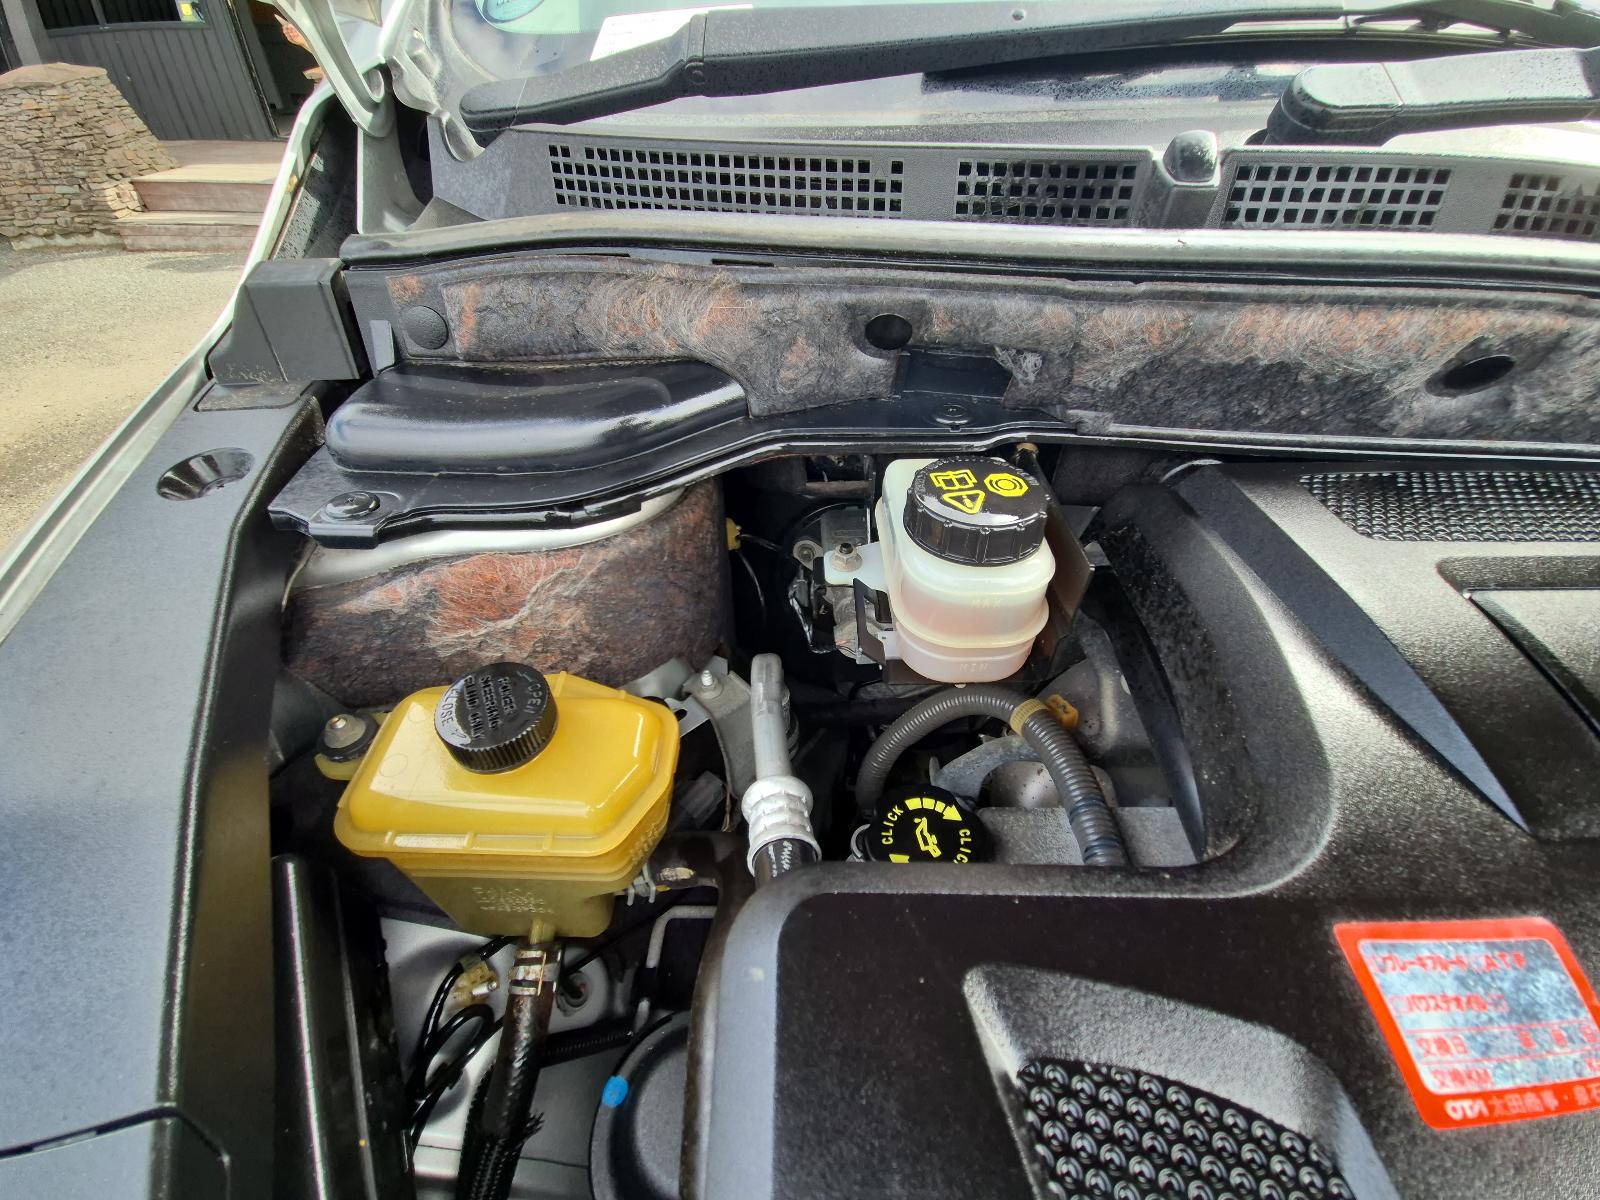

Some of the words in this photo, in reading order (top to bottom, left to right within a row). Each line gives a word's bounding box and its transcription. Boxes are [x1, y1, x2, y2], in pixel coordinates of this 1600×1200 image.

[440, 687, 460, 726] CLOSE
[463, 675, 477, 711] FLUID
[479, 674, 502, 730] STEERING
[497, 675, 517, 716] POWER
[523, 682, 544, 715] OPEN
[468, 711, 486, 742] ONLY
[881, 804, 904, 846] CLICK
[954, 828, 973, 863] CLIC
